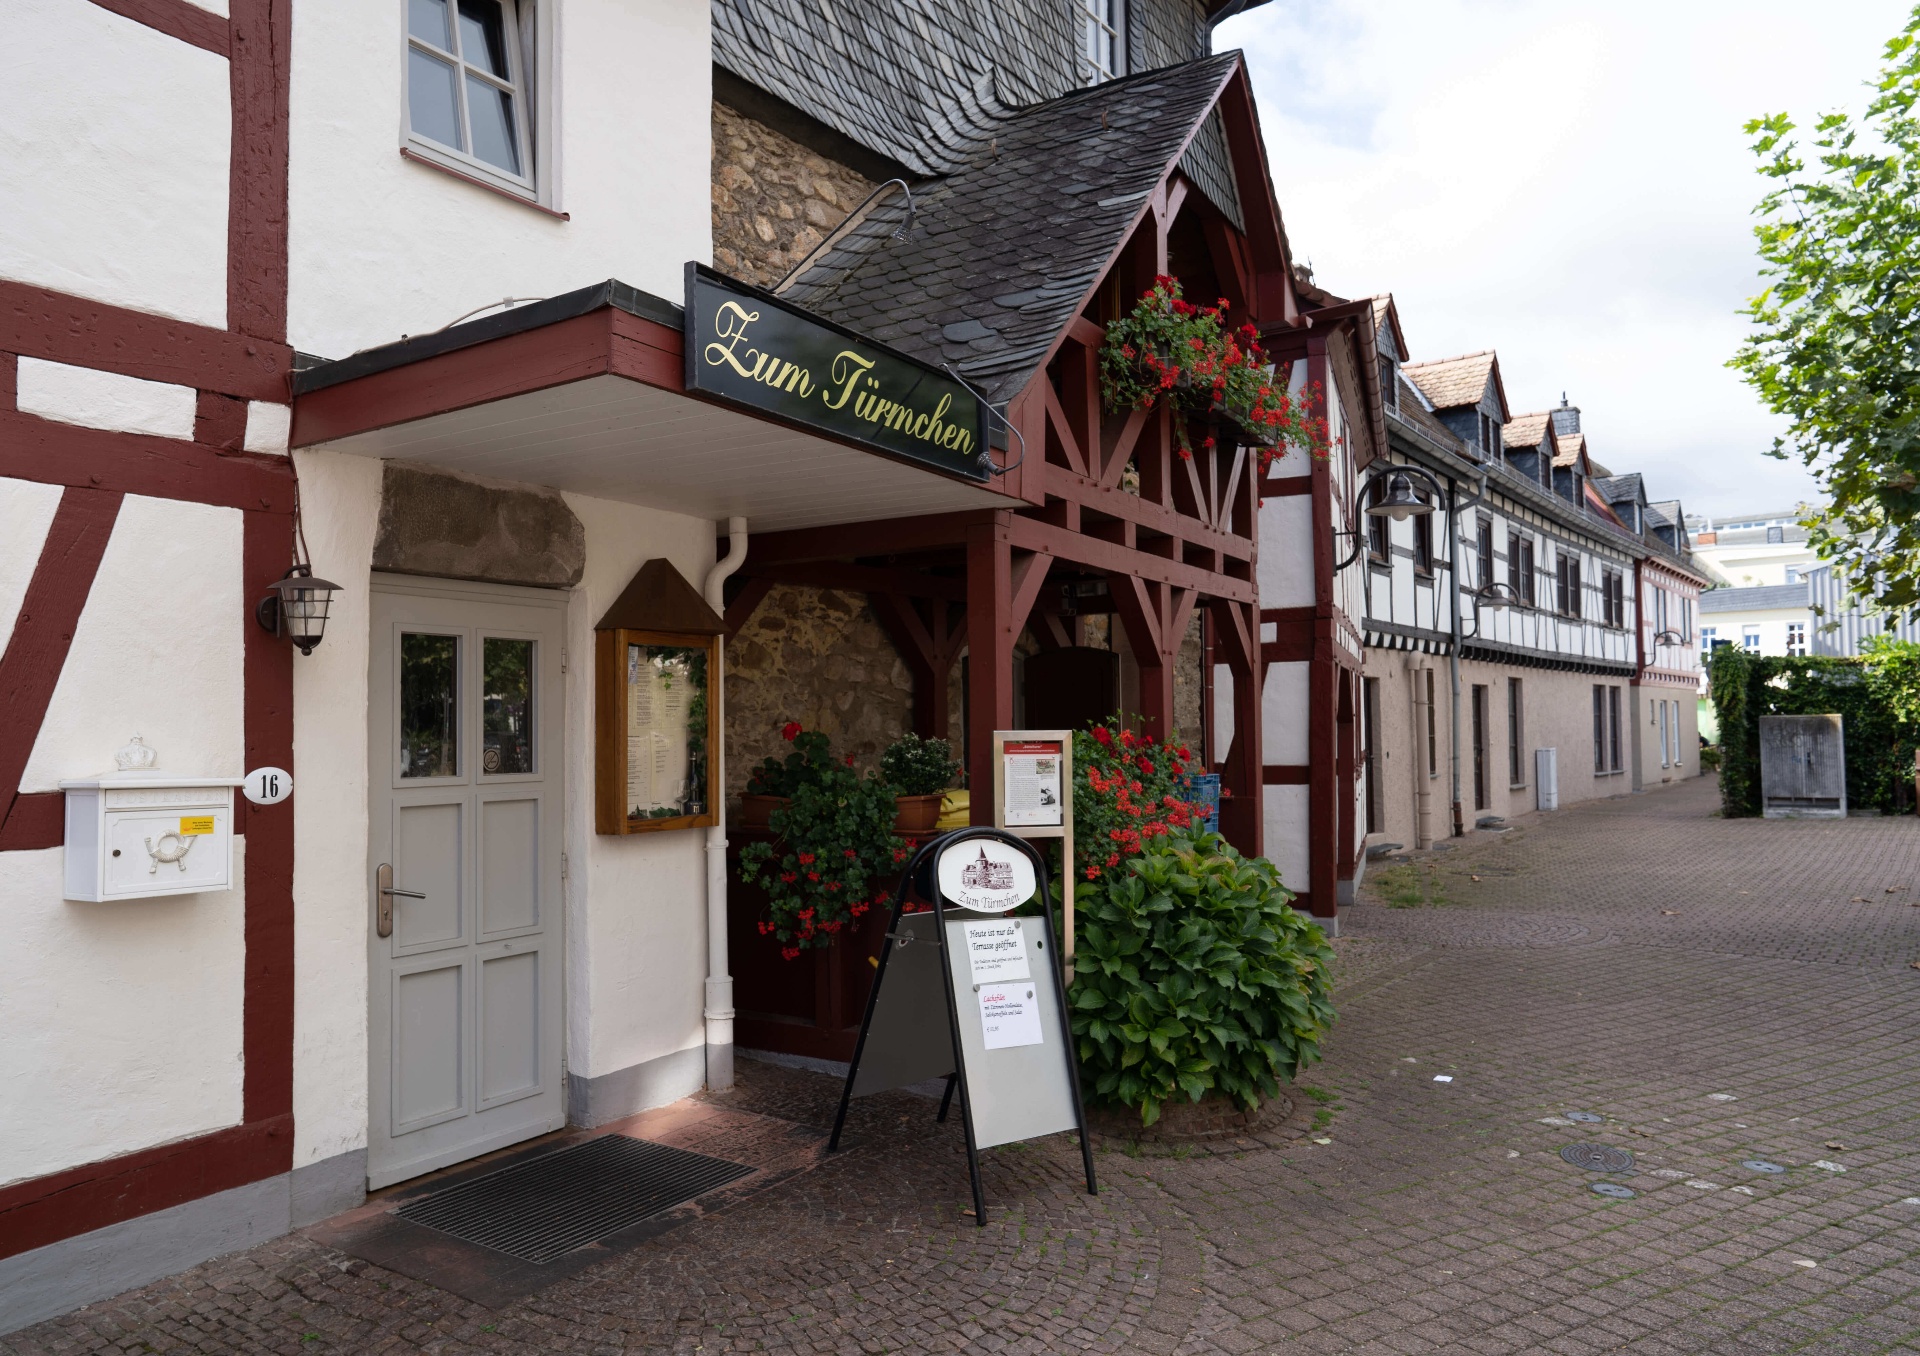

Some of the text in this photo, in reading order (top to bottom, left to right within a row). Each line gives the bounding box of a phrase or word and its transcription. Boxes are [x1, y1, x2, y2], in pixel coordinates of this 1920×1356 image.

[705, 301, 975, 455] Zum Türmchen
[261, 774, 279, 799] 16
[113, 790, 225, 805] POSTKASTEN
[958, 890, 1020, 909] Zum Türmchen
[969, 929, 987, 938] Heute
[1007, 926, 1015, 936] die
[972, 939, 1017, 951] Terrasse geöffnet
